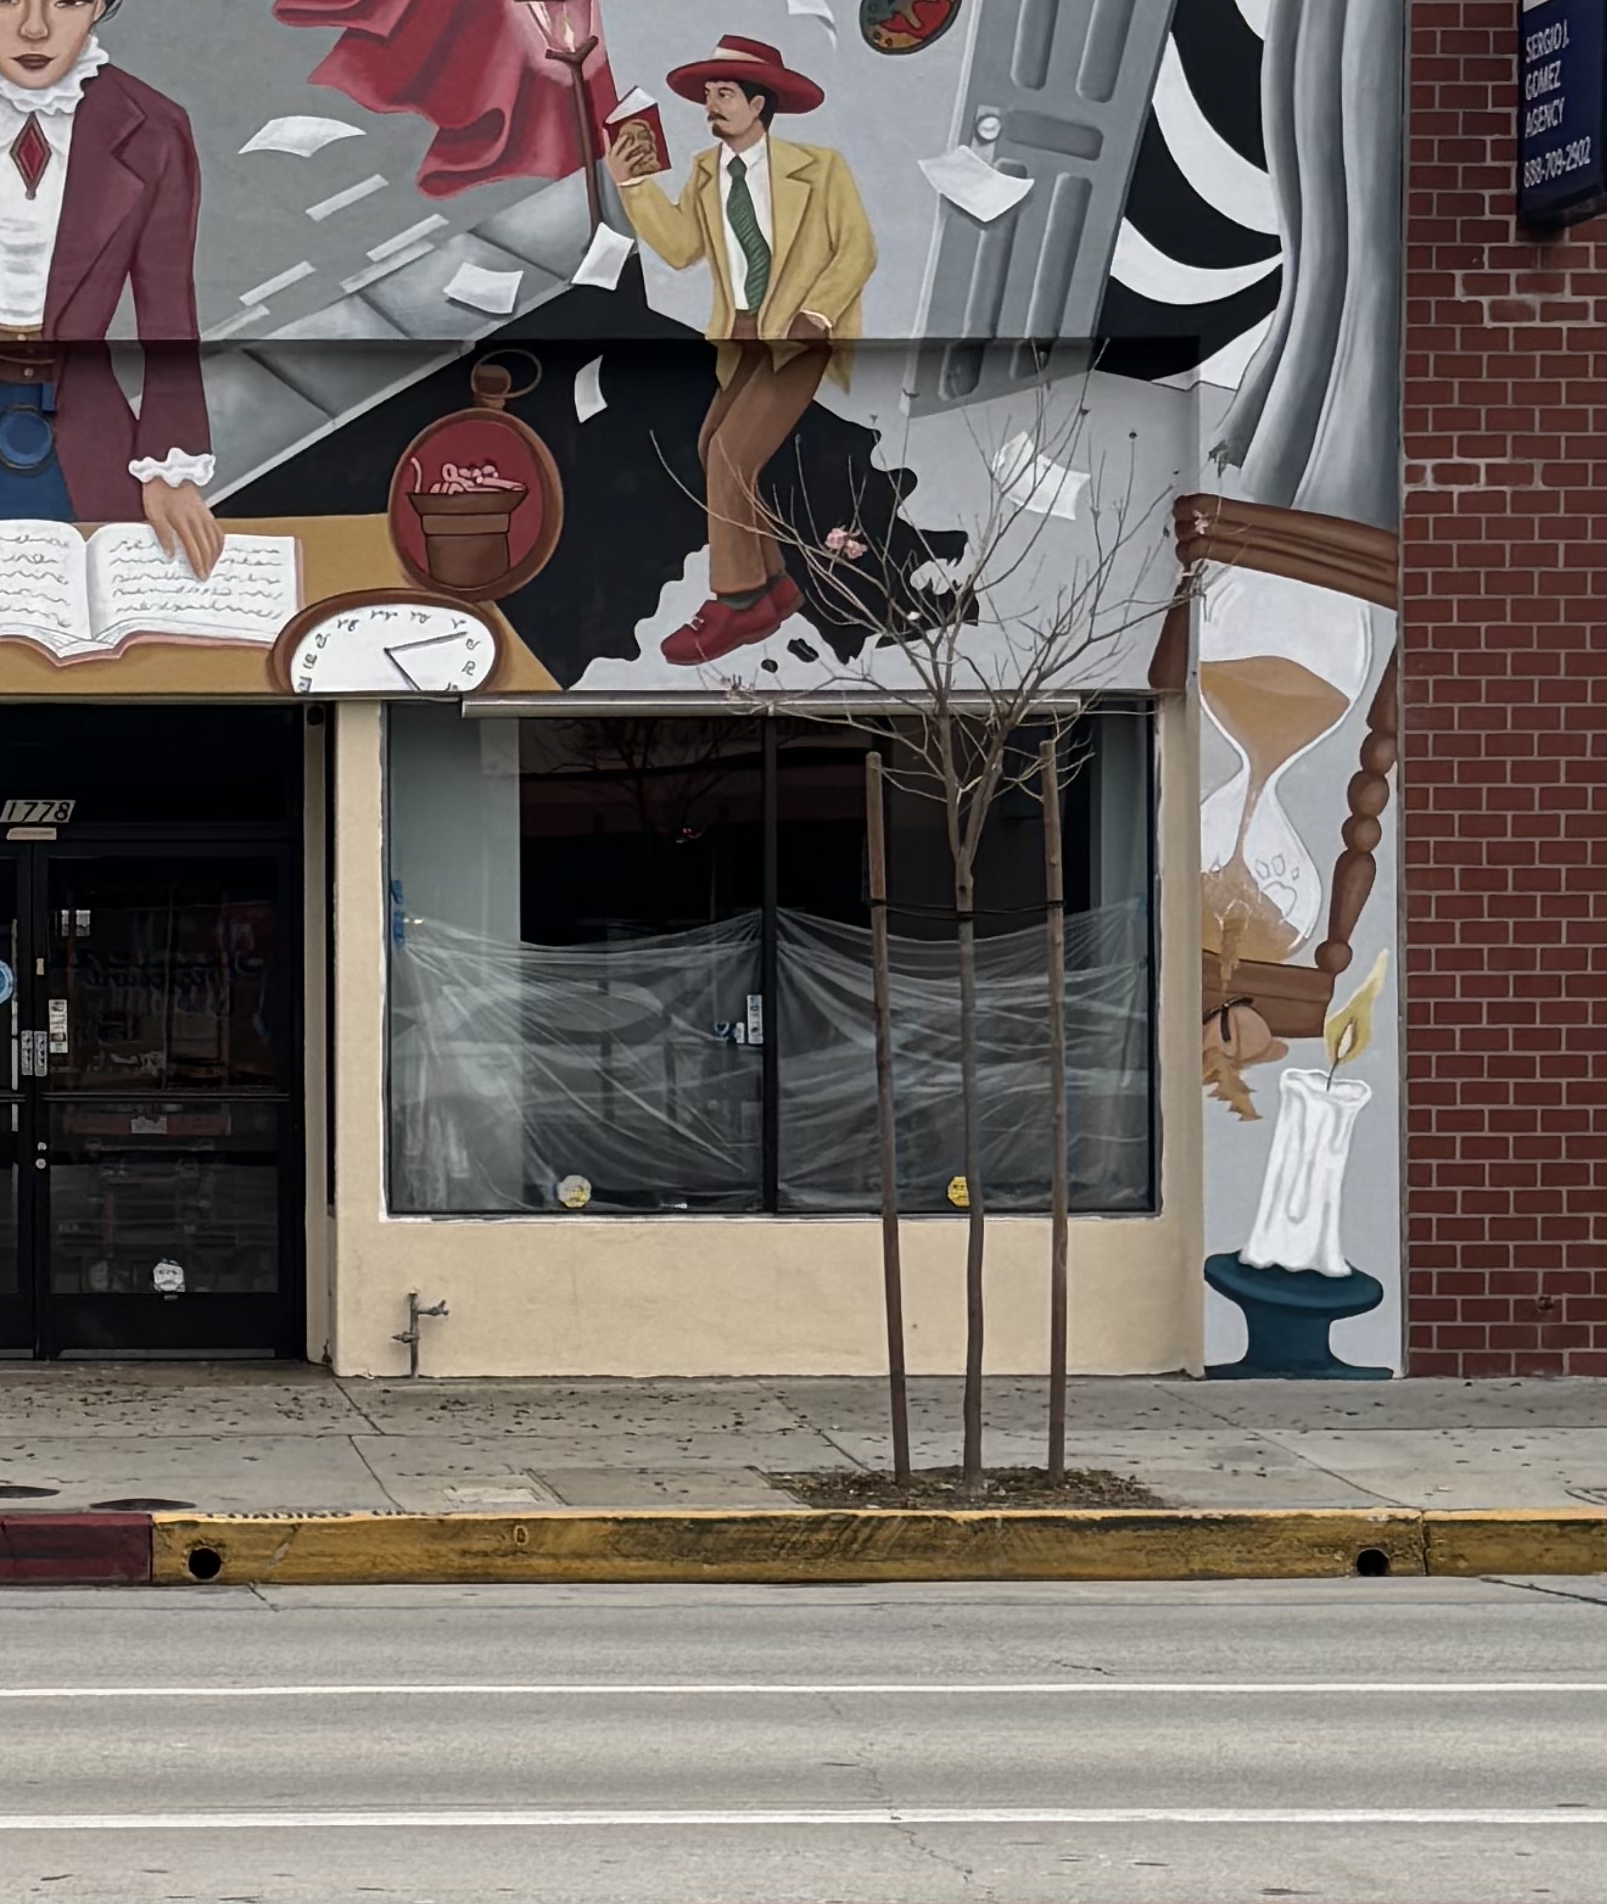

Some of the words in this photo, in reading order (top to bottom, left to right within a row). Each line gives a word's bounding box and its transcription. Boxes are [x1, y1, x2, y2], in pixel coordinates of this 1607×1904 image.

[1525, 22, 1562, 64] SERGIO
[1525, 60, 1562, 101] GOMEZ
[1524, 97, 1566, 139] AGENCY
[1523, 135, 1591, 188] 888-709-2902
[7, 801, 71, 823] 1778
